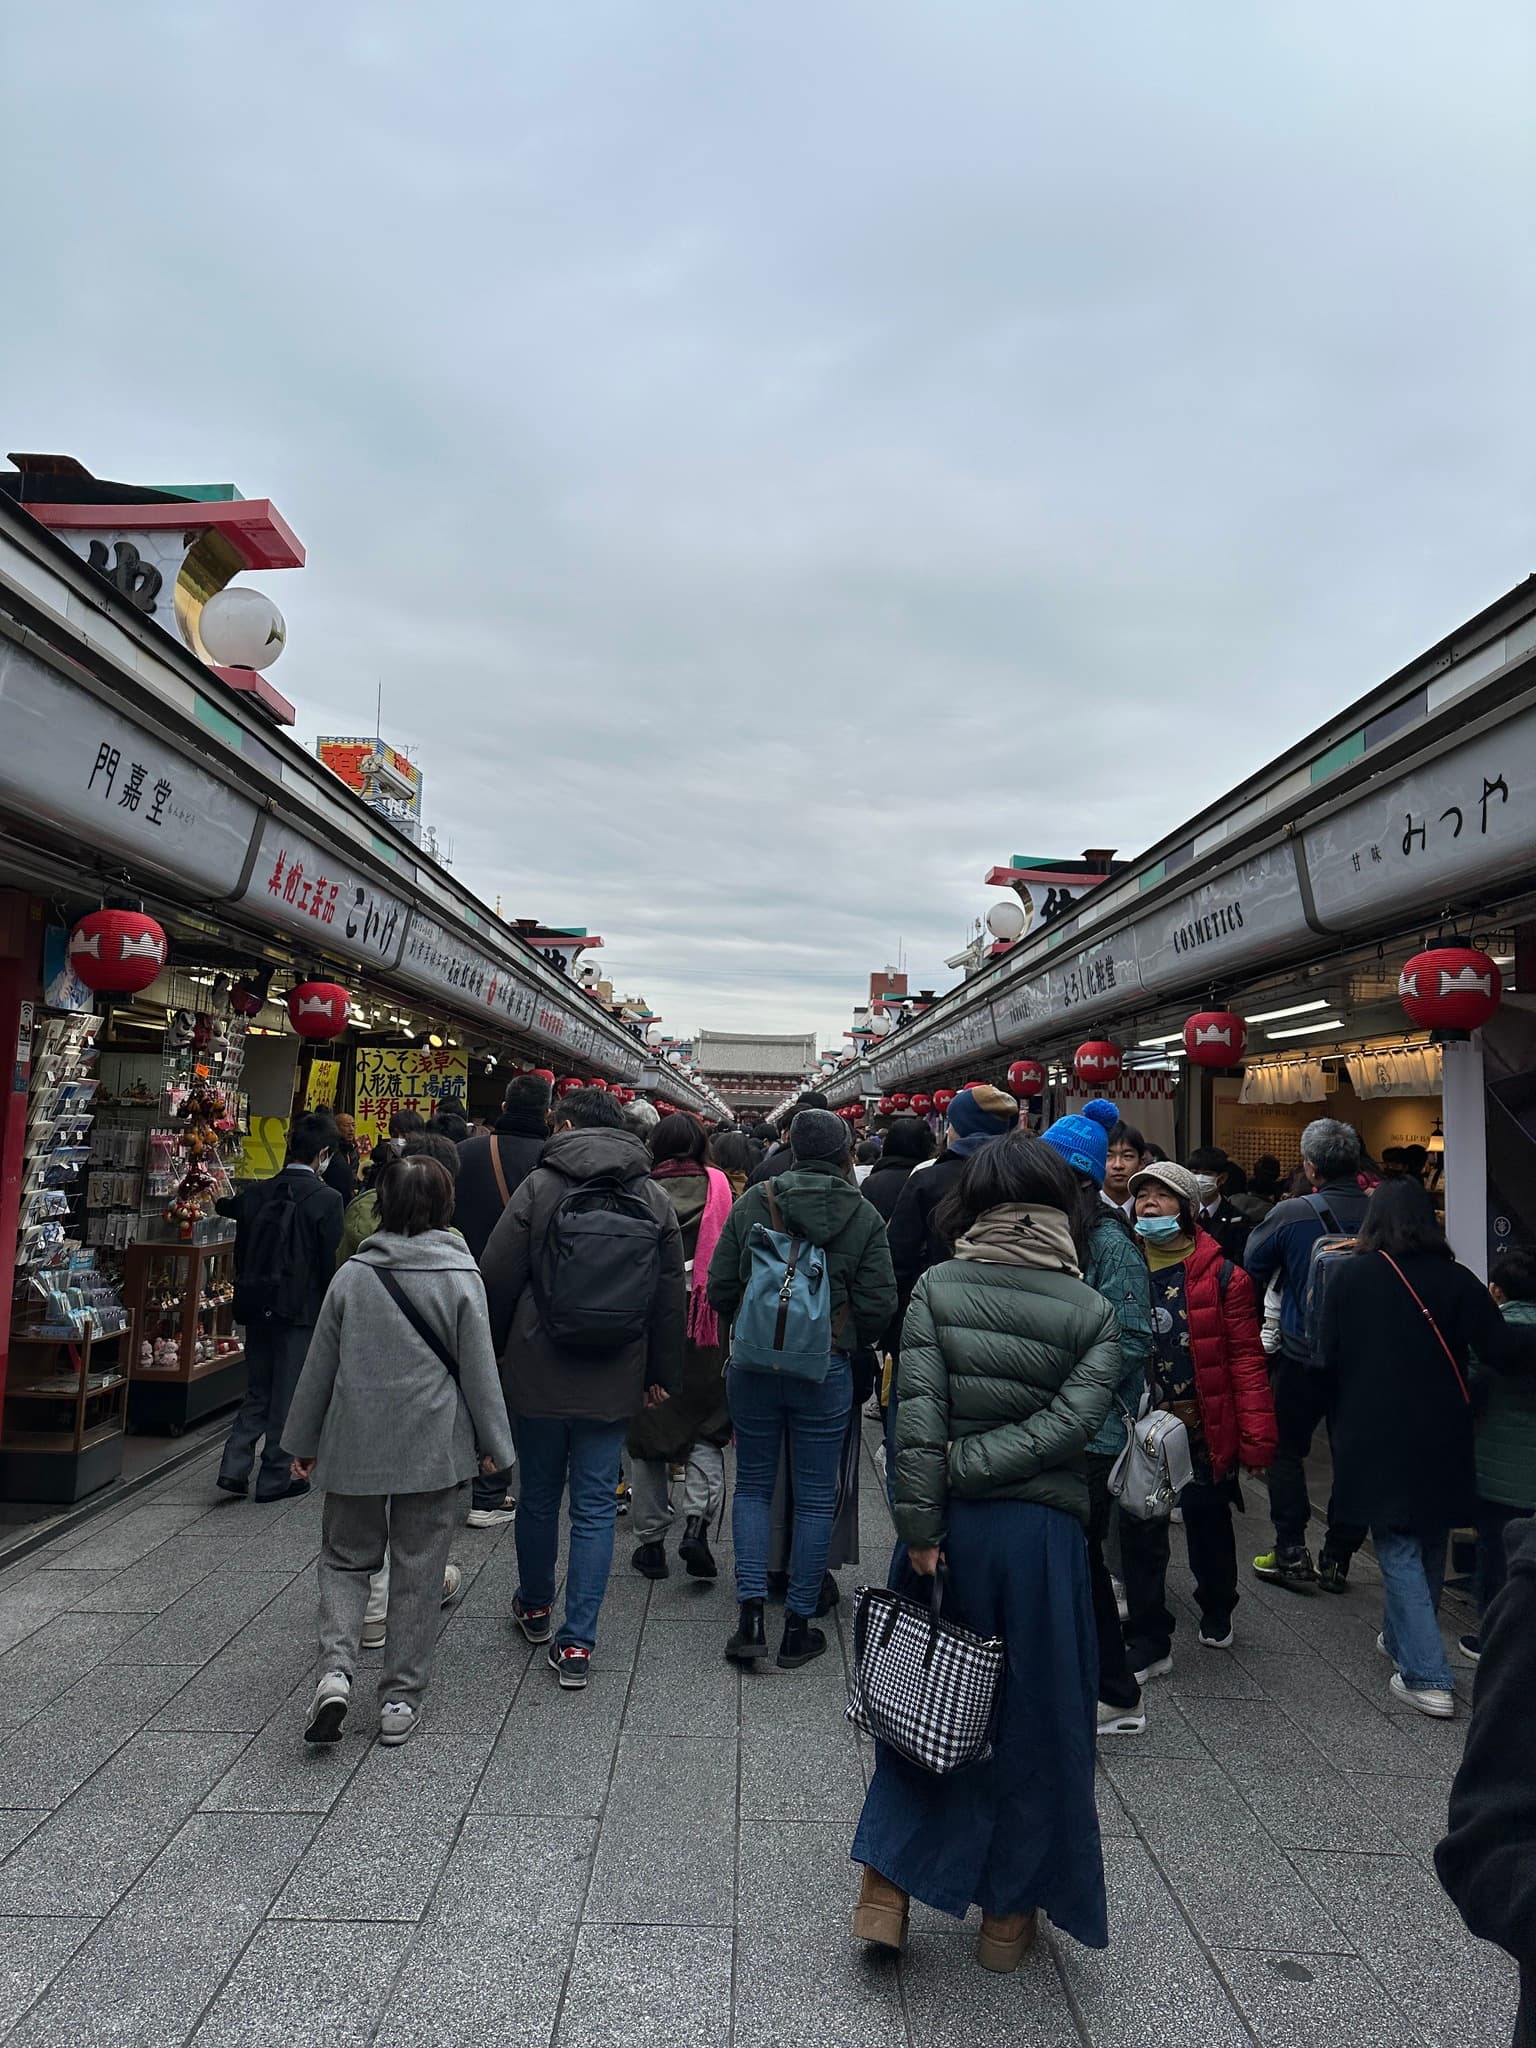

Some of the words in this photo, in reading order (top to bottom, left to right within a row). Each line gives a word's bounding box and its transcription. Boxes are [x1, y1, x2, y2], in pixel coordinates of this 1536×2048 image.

[88, 742, 172, 826] 門嘉堂
[1352, 844, 1382, 873] 甘味
[1402, 773, 1509, 856] みつや
[268, 849, 339, 924] 美術工芸品
[345, 887, 399, 956] こいけ
[1173, 901, 1244, 954] COSMETICS
[1064, 954, 1117, 1007] よろし化粧堂
[356, 1050, 467, 1074] ようこそ浅草へ
